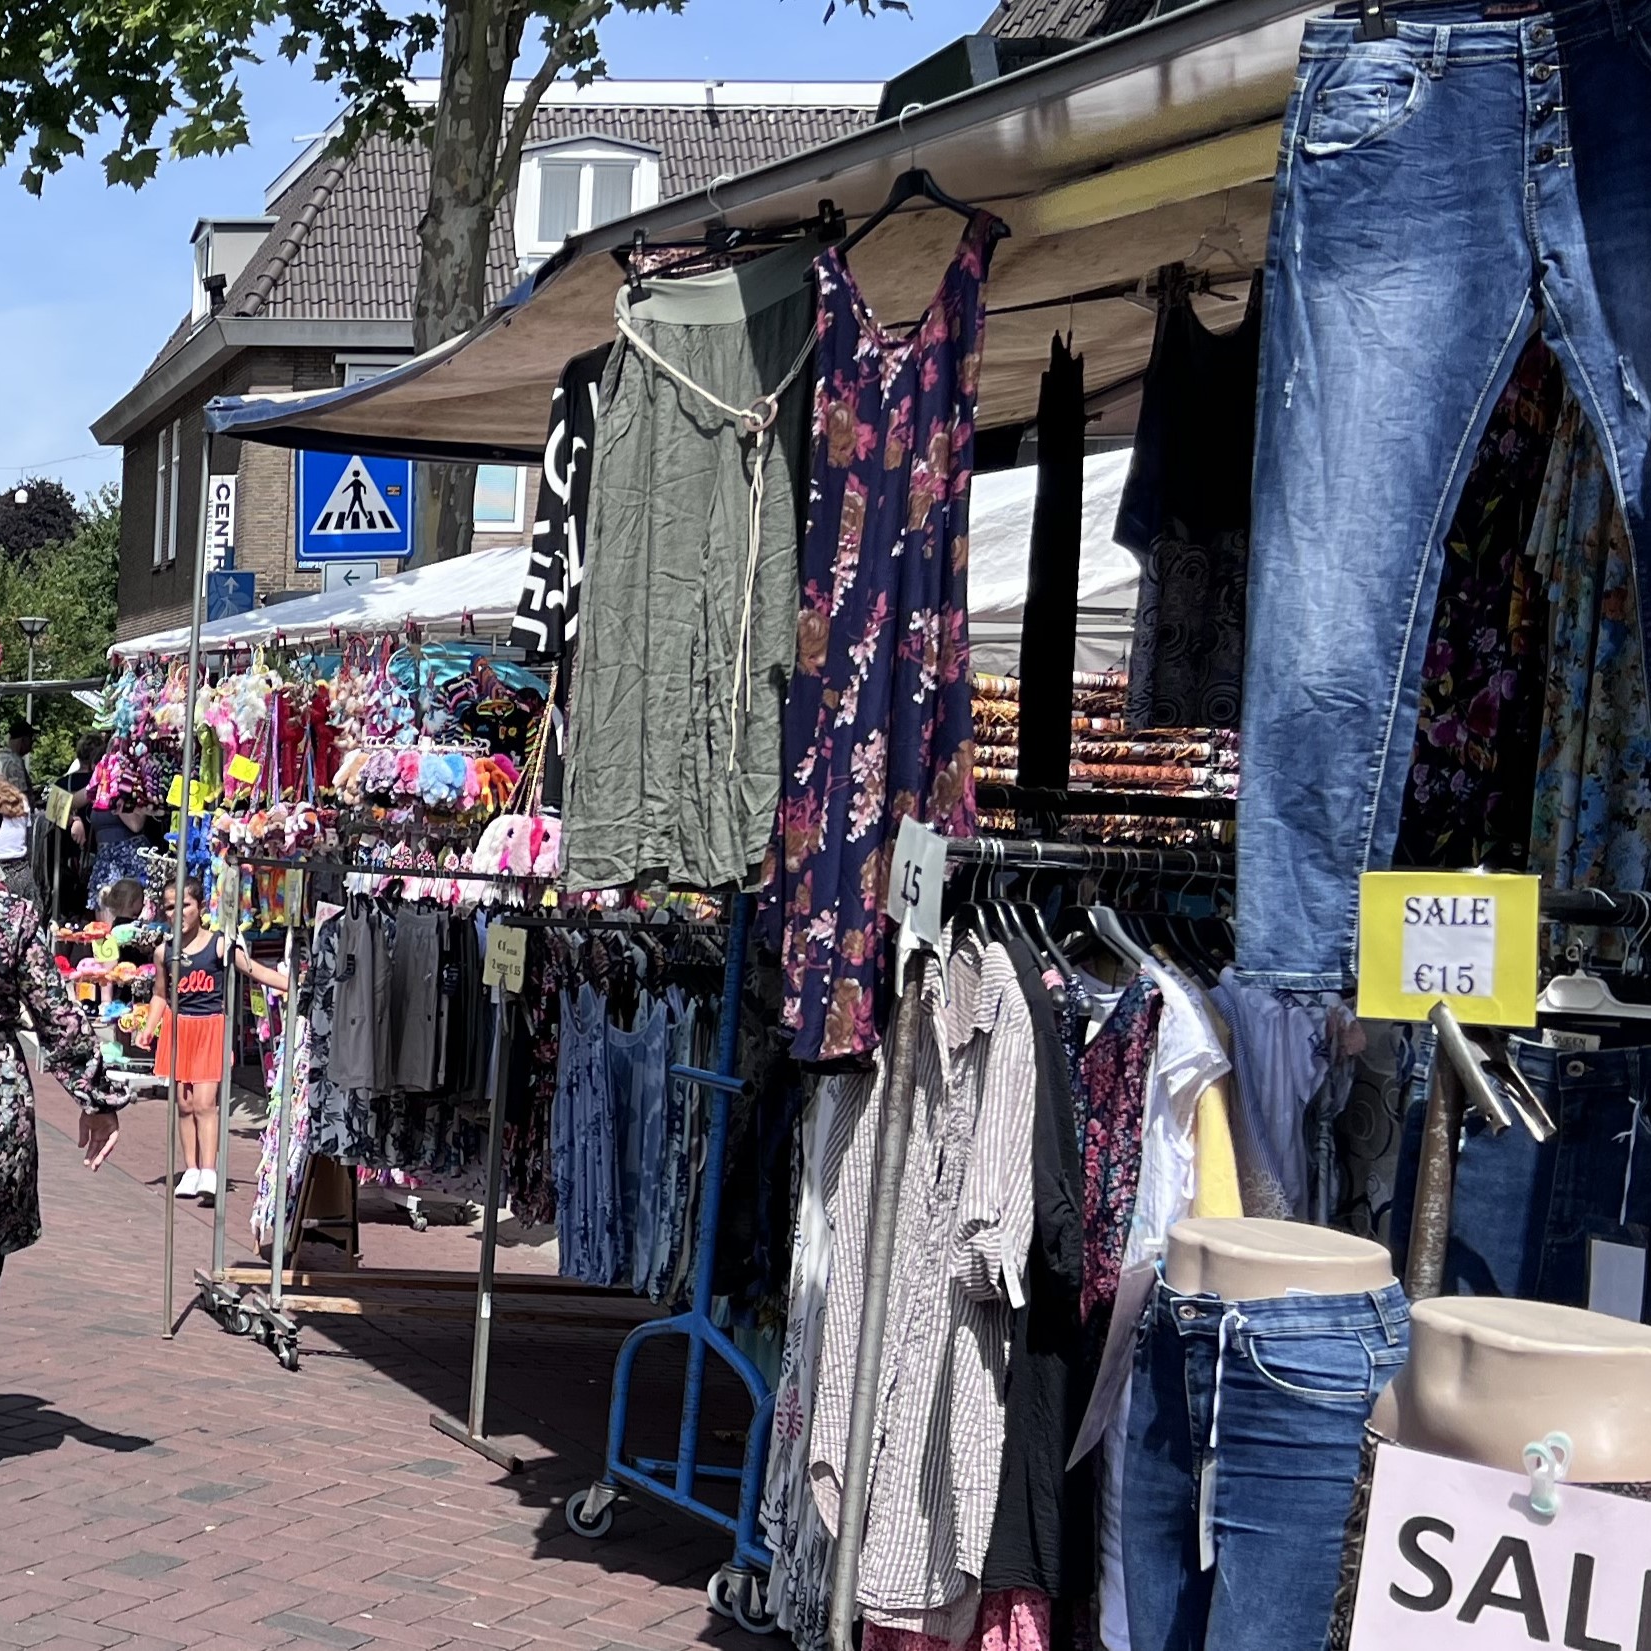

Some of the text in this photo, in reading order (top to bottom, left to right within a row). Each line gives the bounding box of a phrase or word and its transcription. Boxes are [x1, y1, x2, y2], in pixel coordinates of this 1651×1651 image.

[212, 482, 231, 572] CENTR
[900, 860, 922, 906] 15
[1404, 897, 1490, 926] SALE
[176, 969, 215, 993] ella
[1414, 963, 1475, 994] €15
